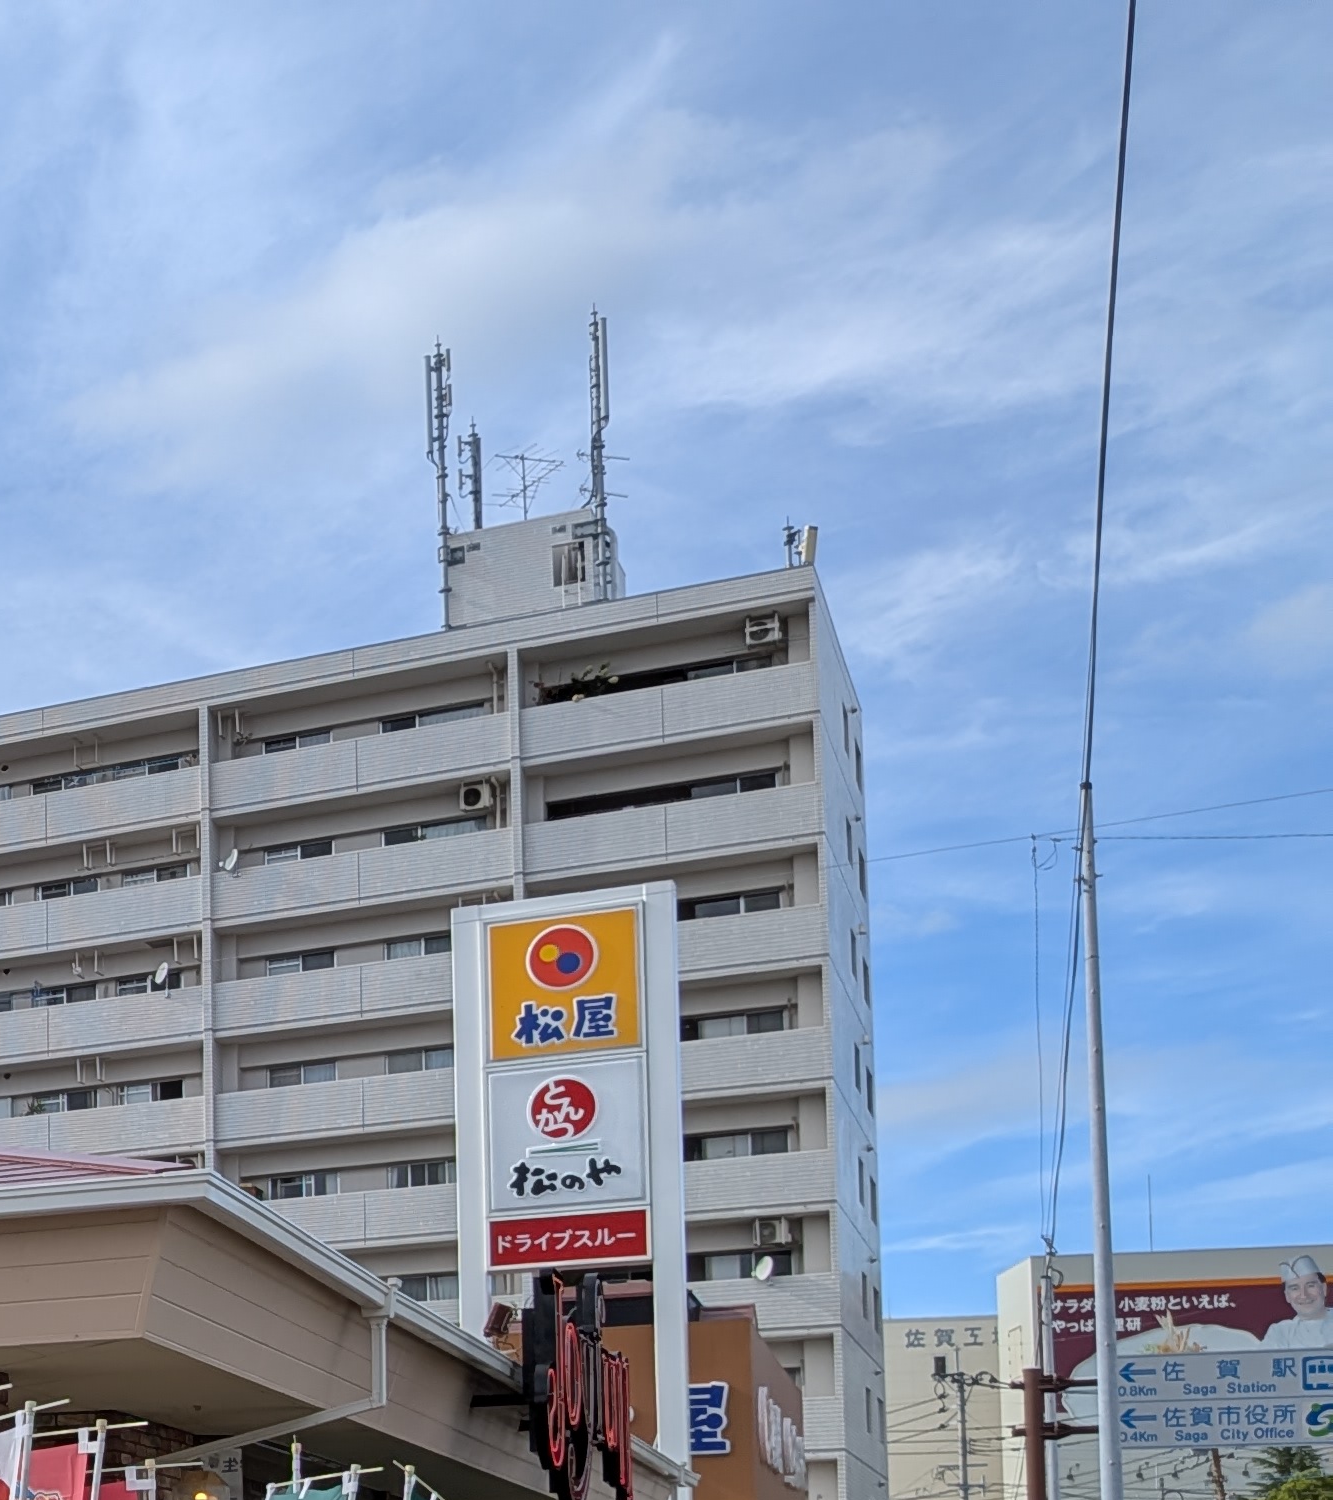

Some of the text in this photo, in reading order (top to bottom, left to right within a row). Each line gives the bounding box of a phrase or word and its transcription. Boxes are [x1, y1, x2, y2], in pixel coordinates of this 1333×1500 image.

[512, 993, 618, 1046] 松屋
[508, 1157, 622, 1198] 松のや
[496, 1229, 637, 1254] ドライブスルー
[905, 1326, 998, 1349] 佐賀工
[1162, 1357, 1298, 1382] 佐賀駅
[1183, 1382, 1277, 1397] Saga Station
[1162, 1404, 1297, 1428] 佐賀市役所
[1174, 1426, 1295, 1443] Saga City Office
